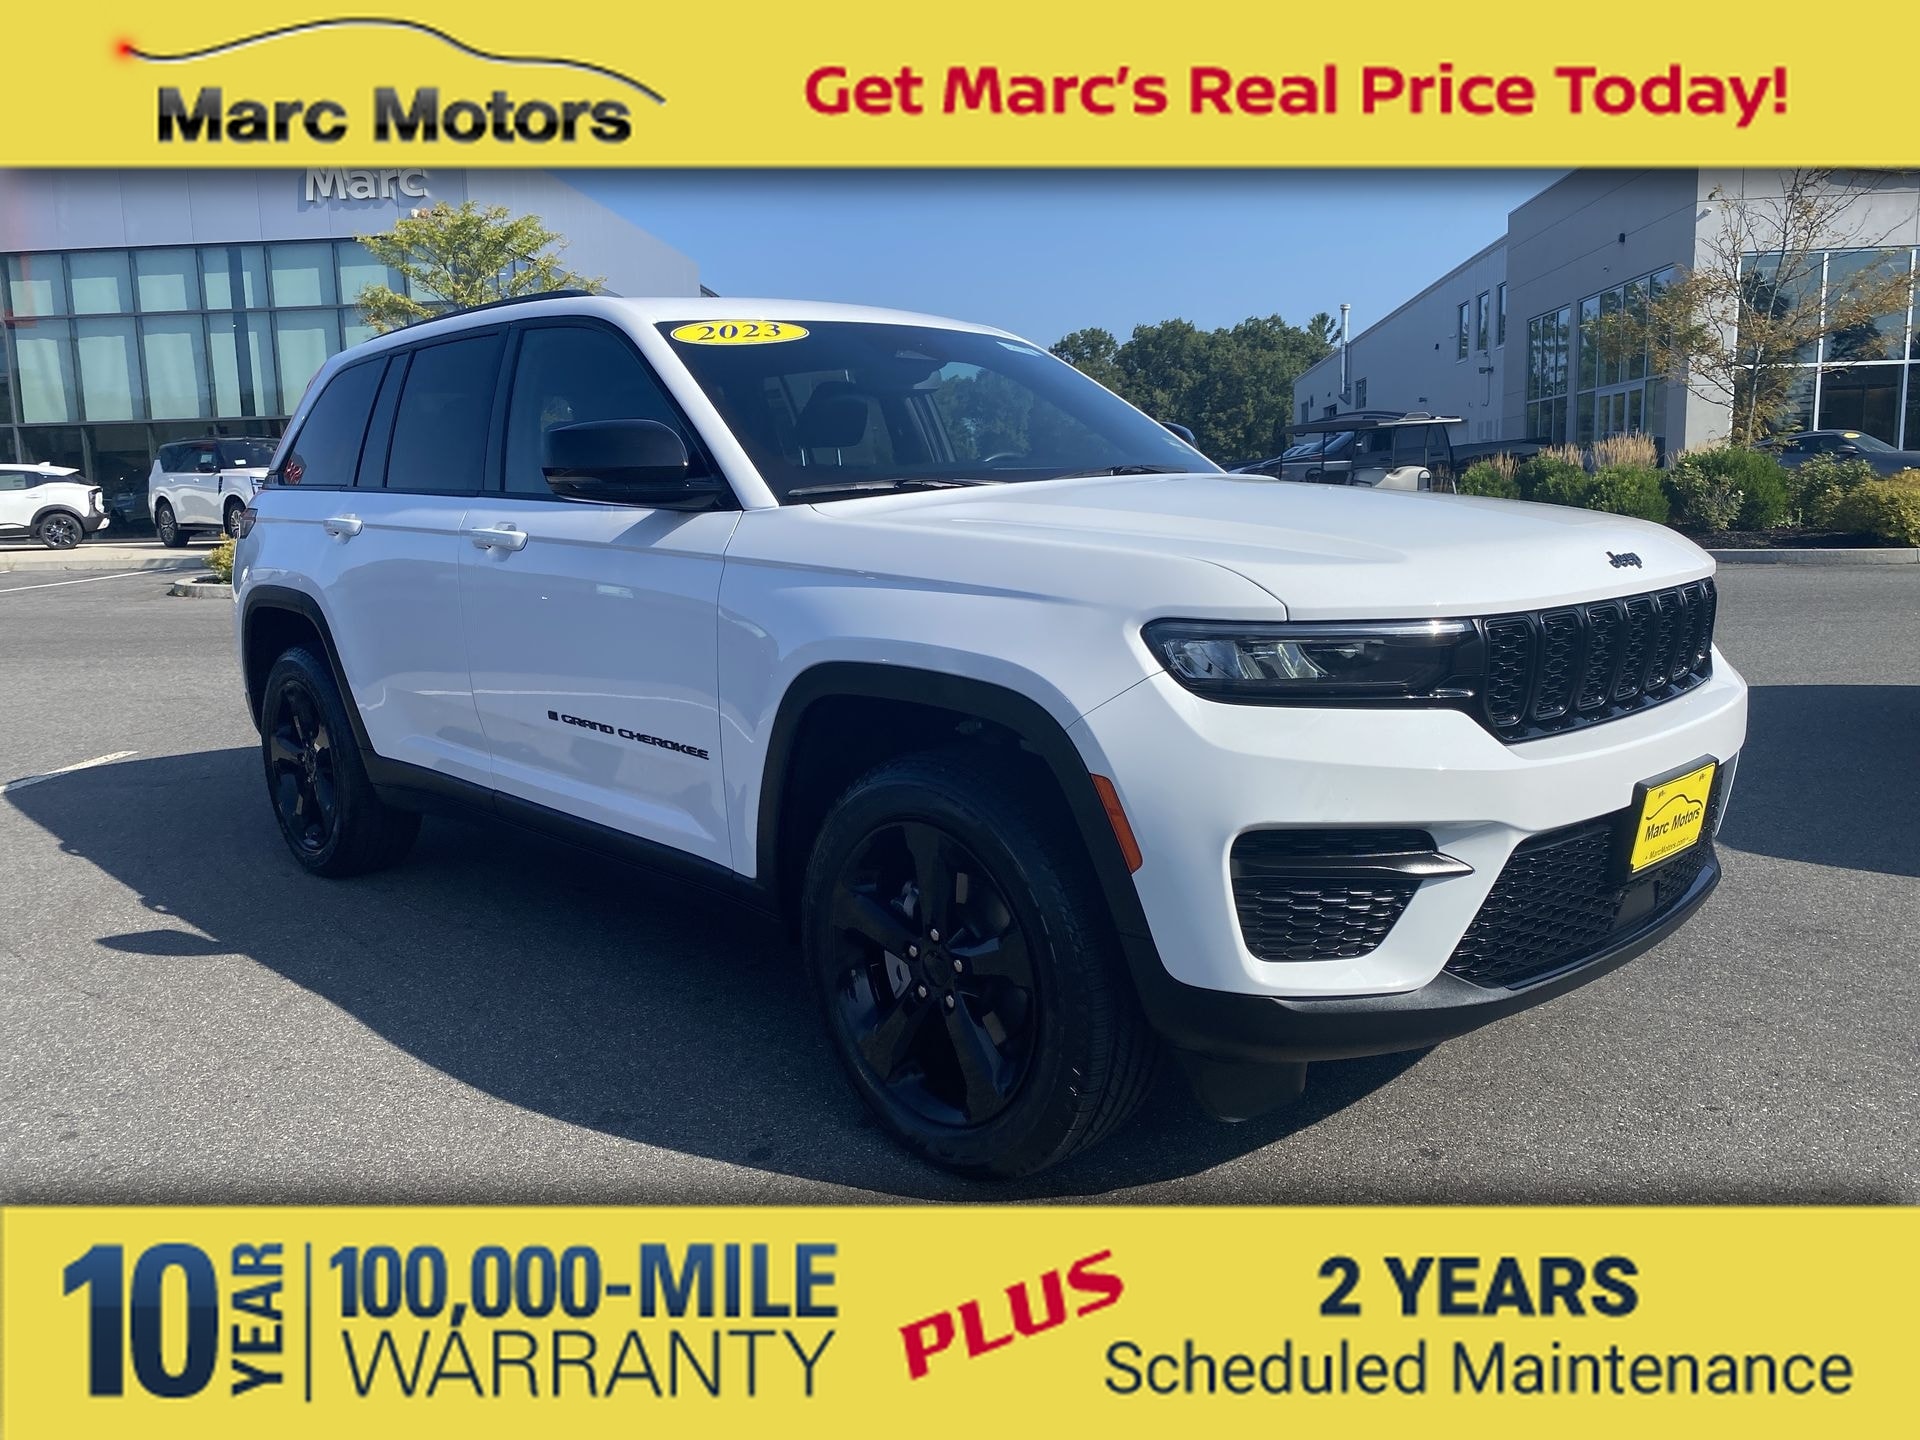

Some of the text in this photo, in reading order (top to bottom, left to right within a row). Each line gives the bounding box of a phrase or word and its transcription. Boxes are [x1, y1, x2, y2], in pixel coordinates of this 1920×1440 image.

[305, 167, 426, 202] Marc
[697, 323, 781, 341] 2023
[1606, 550, 1643, 570] Jeep
[561, 714, 710, 761] GRAND CHEROKEE
[1645, 808, 1700, 841] Marc Motors
